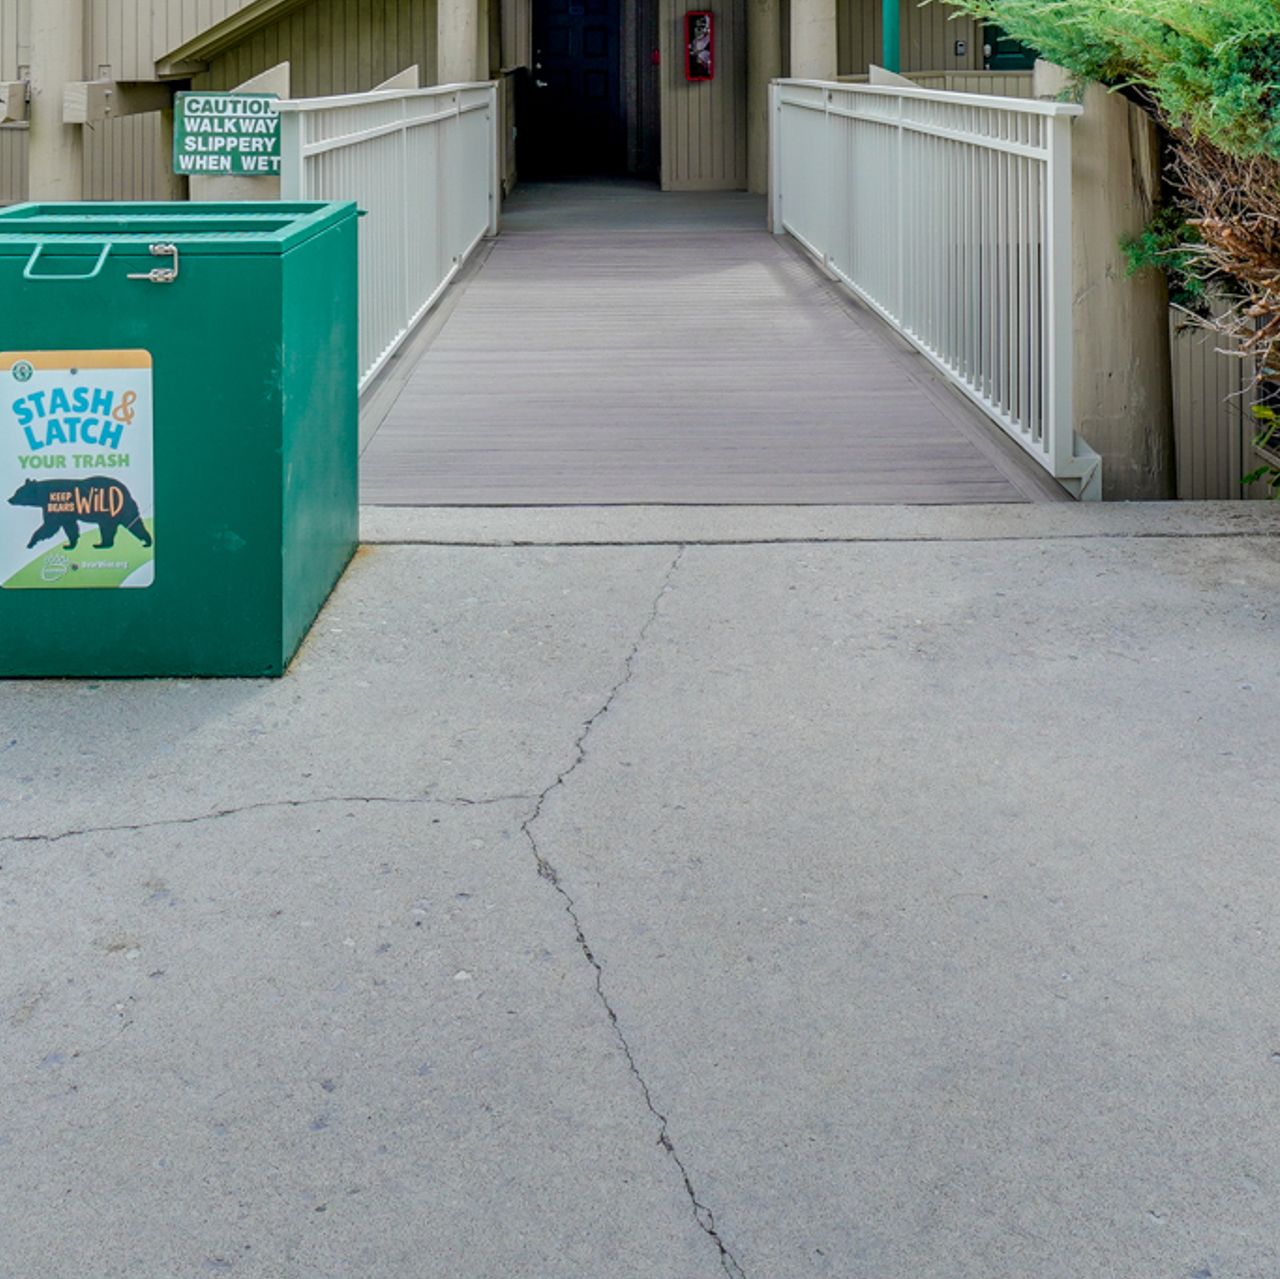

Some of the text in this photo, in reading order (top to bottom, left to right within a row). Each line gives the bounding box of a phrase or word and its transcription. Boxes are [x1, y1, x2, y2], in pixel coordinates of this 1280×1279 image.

[184, 119, 278, 133] WALKWAY
[185, 137, 276, 151] SLIPPERY
[179, 155, 281, 170] WHEN WET
[12, 386, 137, 426] STASH &
[23, 418, 124, 451] LATCH
[18, 454, 130, 469] YOUR TRASH
[49, 492, 72, 501] KEEP
[47, 502, 75, 512] BEARS
